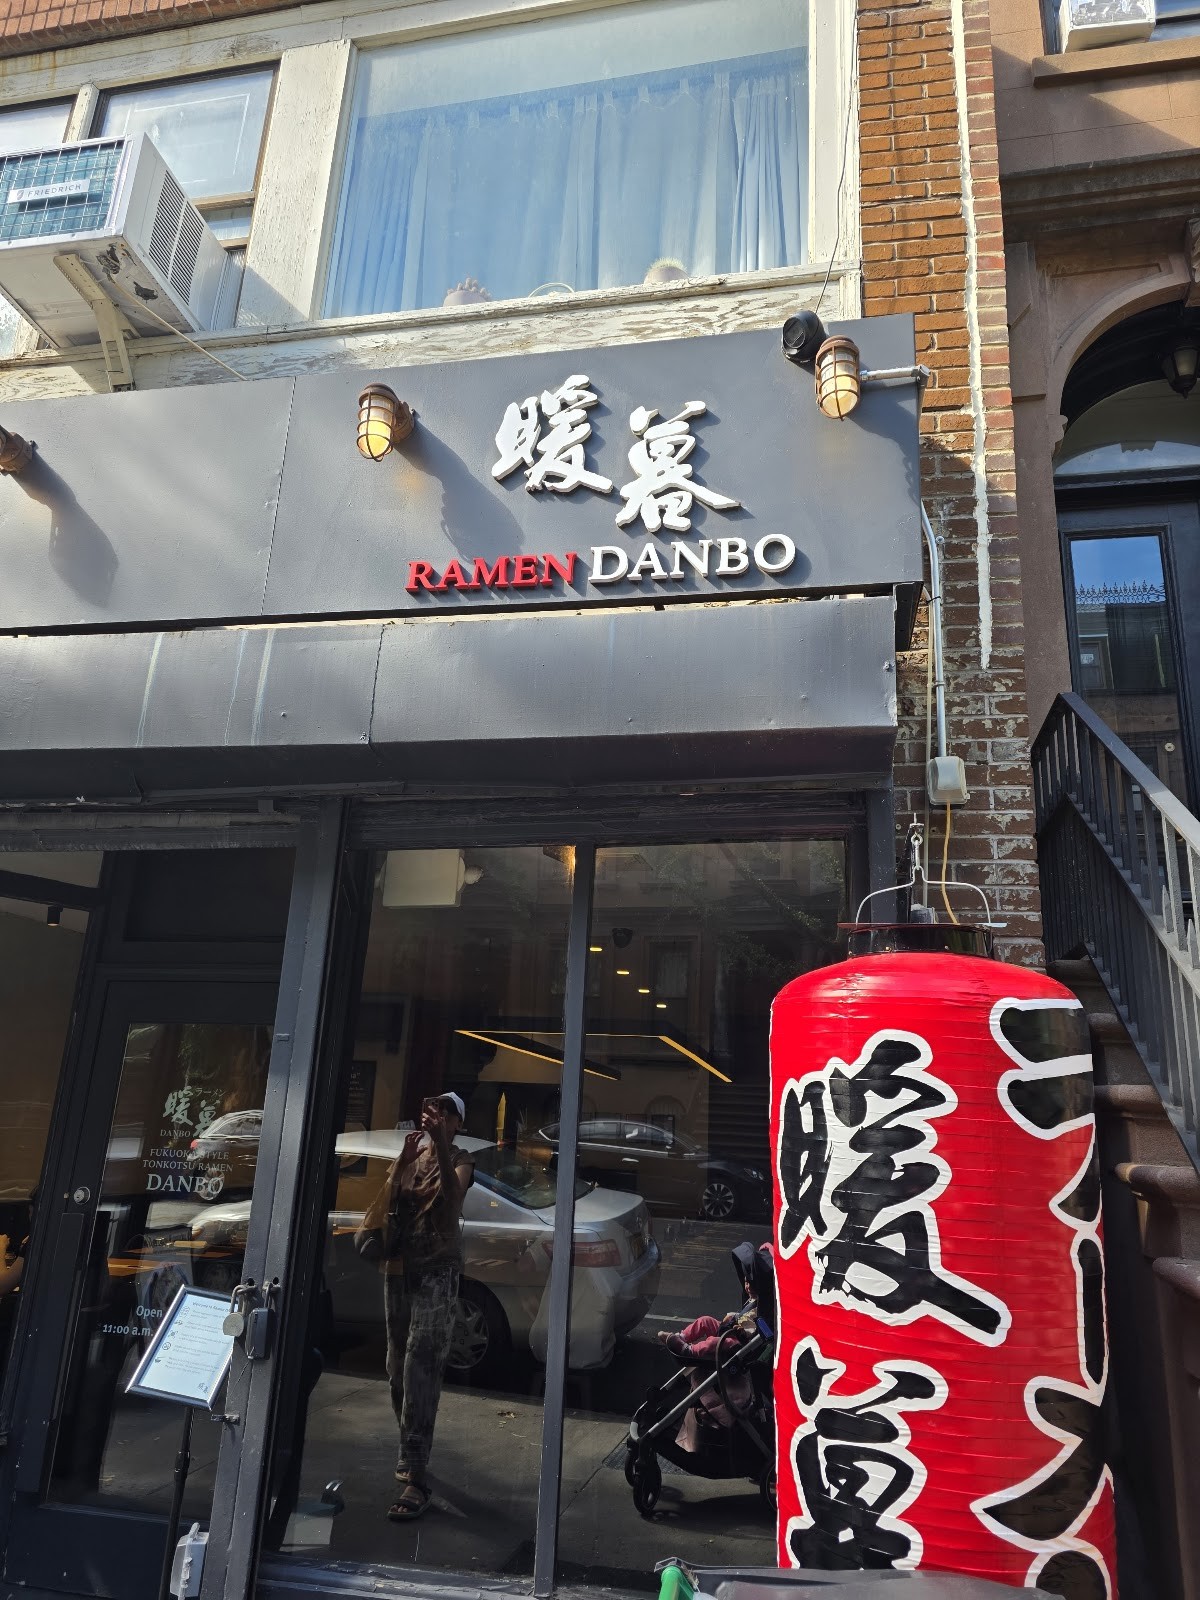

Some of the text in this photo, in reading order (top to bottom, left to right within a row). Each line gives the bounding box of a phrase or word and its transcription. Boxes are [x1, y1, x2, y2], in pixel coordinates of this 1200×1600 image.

[28, 184, 81, 197] FRIEDRICH
[491, 374, 742, 533] 暖暮
[405, 533, 796, 593] RAMEN DANBO
[160, 1129, 191, 1138] DANBO
[143, 1159, 234, 1173] TONKOTSU RAMEN
[146, 1173, 224, 1194] DANBO
[136, 1305, 163, 1320] Open
[102, 1324, 154, 1337] 11:00 a.m.
